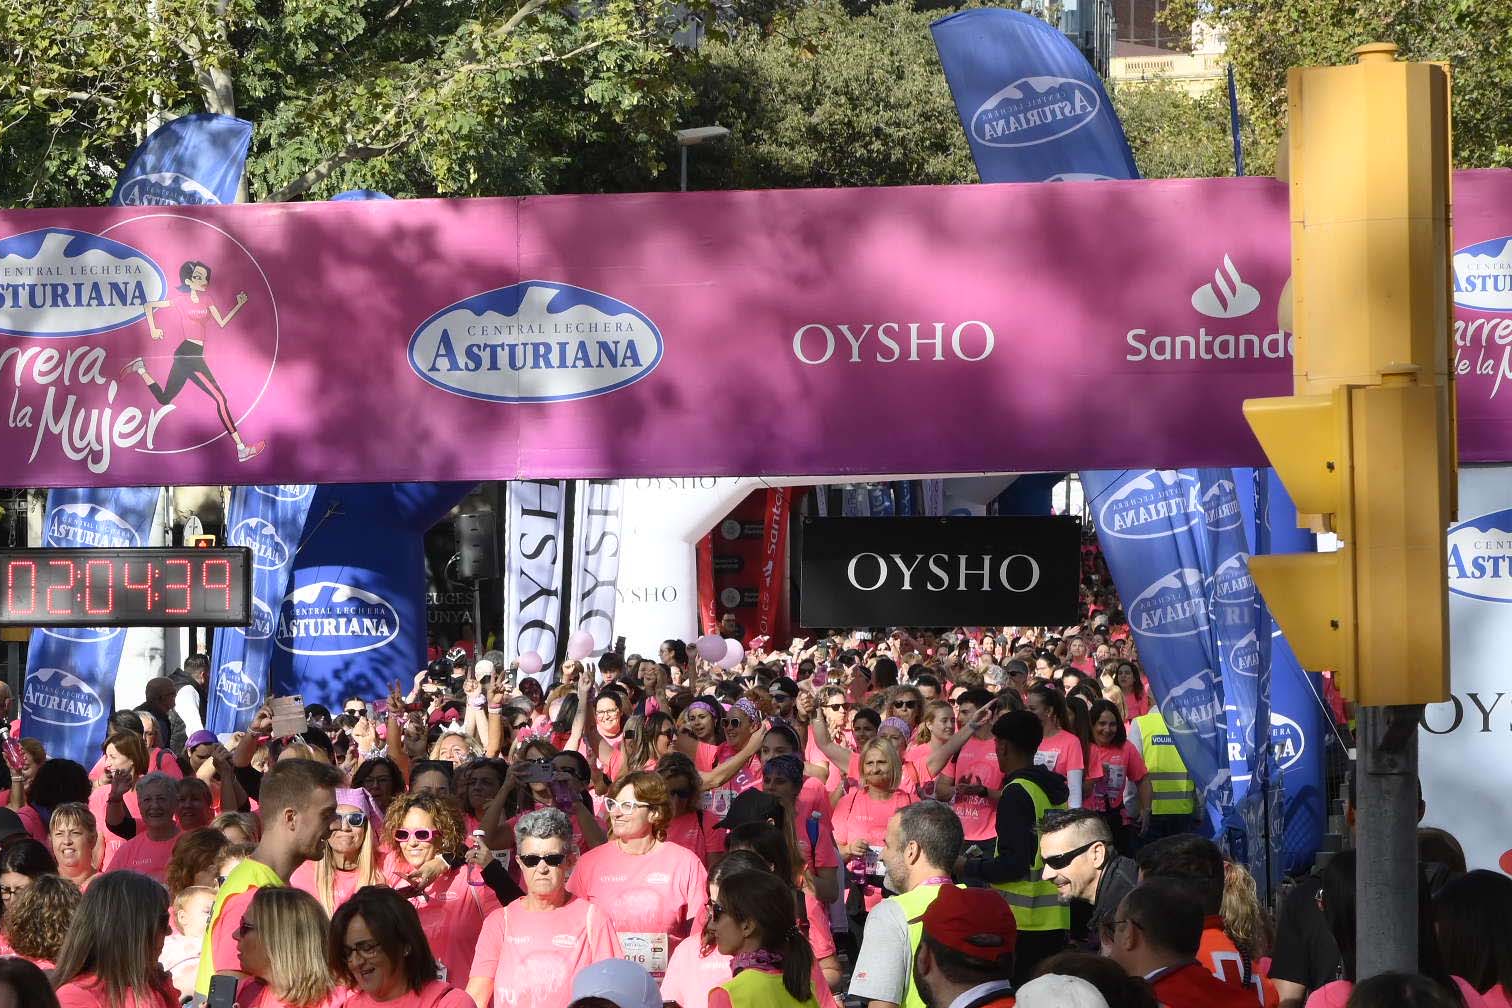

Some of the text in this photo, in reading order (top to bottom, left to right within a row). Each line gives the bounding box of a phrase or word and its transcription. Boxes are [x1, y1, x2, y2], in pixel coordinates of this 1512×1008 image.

[70, 265, 143, 276] LECHERA
[467, 322, 635, 336] CENTRAL LECHERA
[792, 320, 996, 365] OYSHO
[1126, 328, 1294, 362] Santand
[427, 328, 643, 372] ASTURIANA
[8, 388, 34, 429] la
[28, 380, 178, 474] Mujer
[7, 560, 231, 616] 02:04:39
[847, 552, 1041, 593] OYSHO
[277, 615, 390, 639] ASTURIANA
